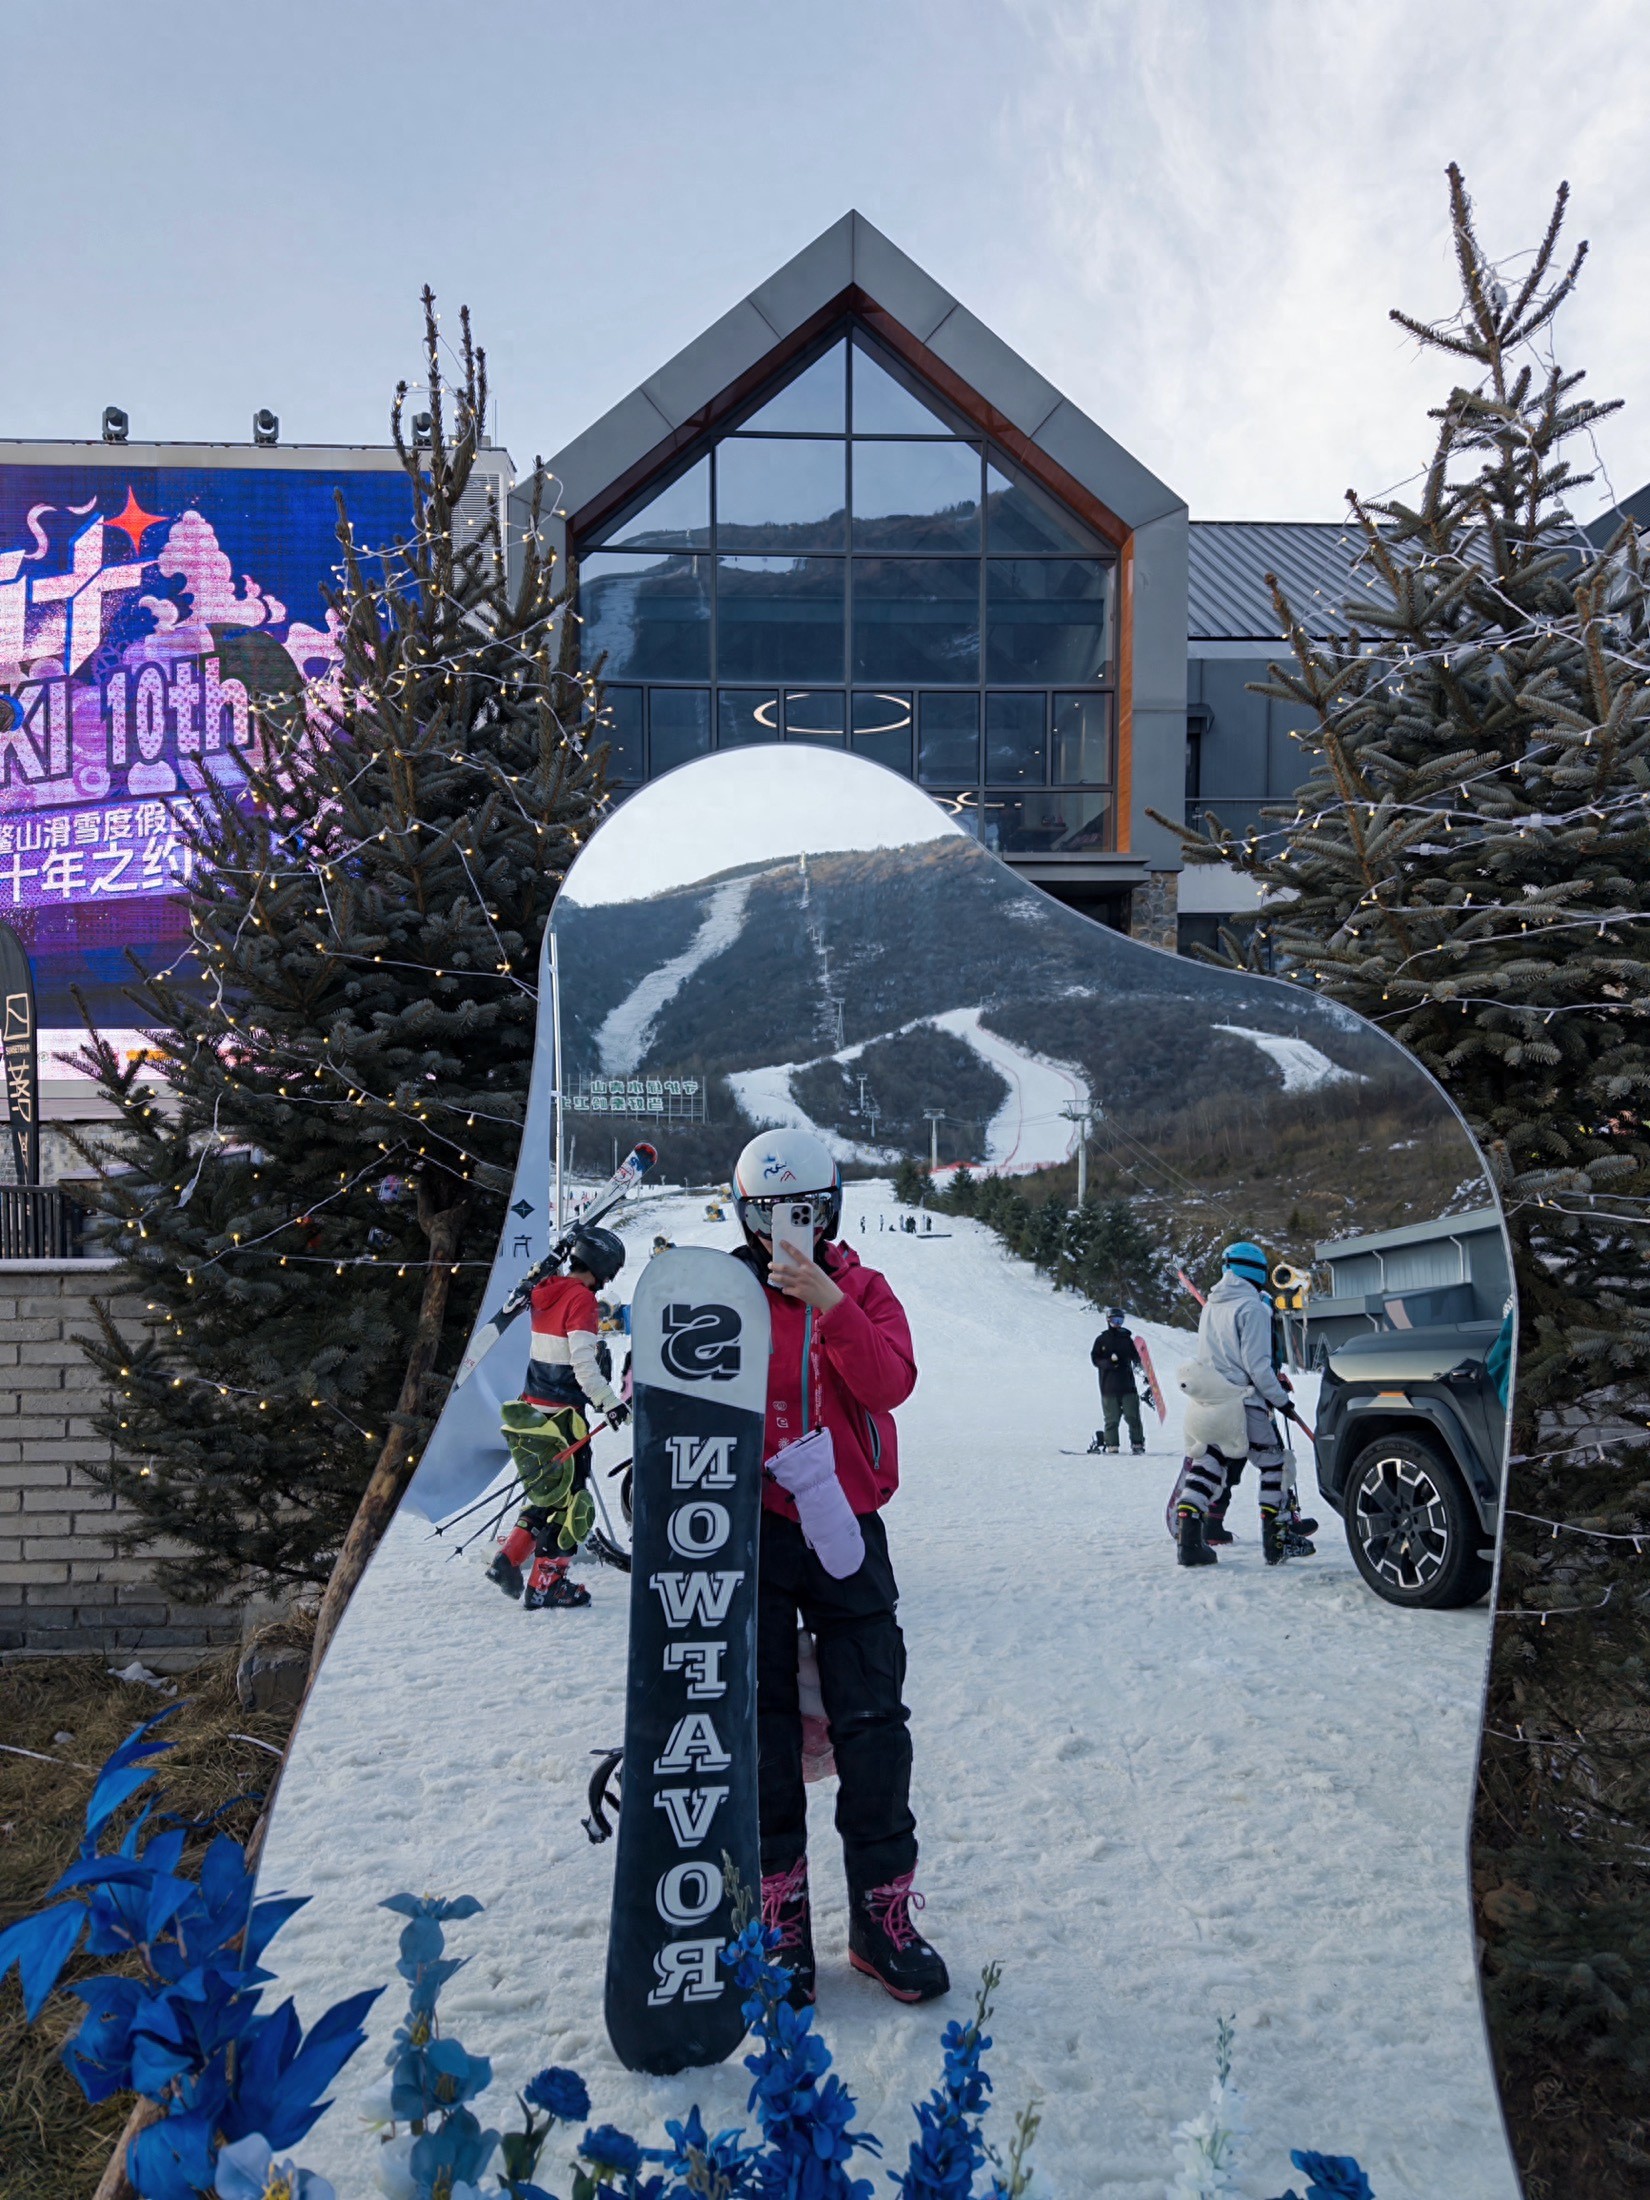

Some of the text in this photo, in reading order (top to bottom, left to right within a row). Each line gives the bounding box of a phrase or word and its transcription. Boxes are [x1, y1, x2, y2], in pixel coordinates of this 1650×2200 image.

[107, 657, 249, 765] 10th
[0, 836, 193, 902] 十年之约
